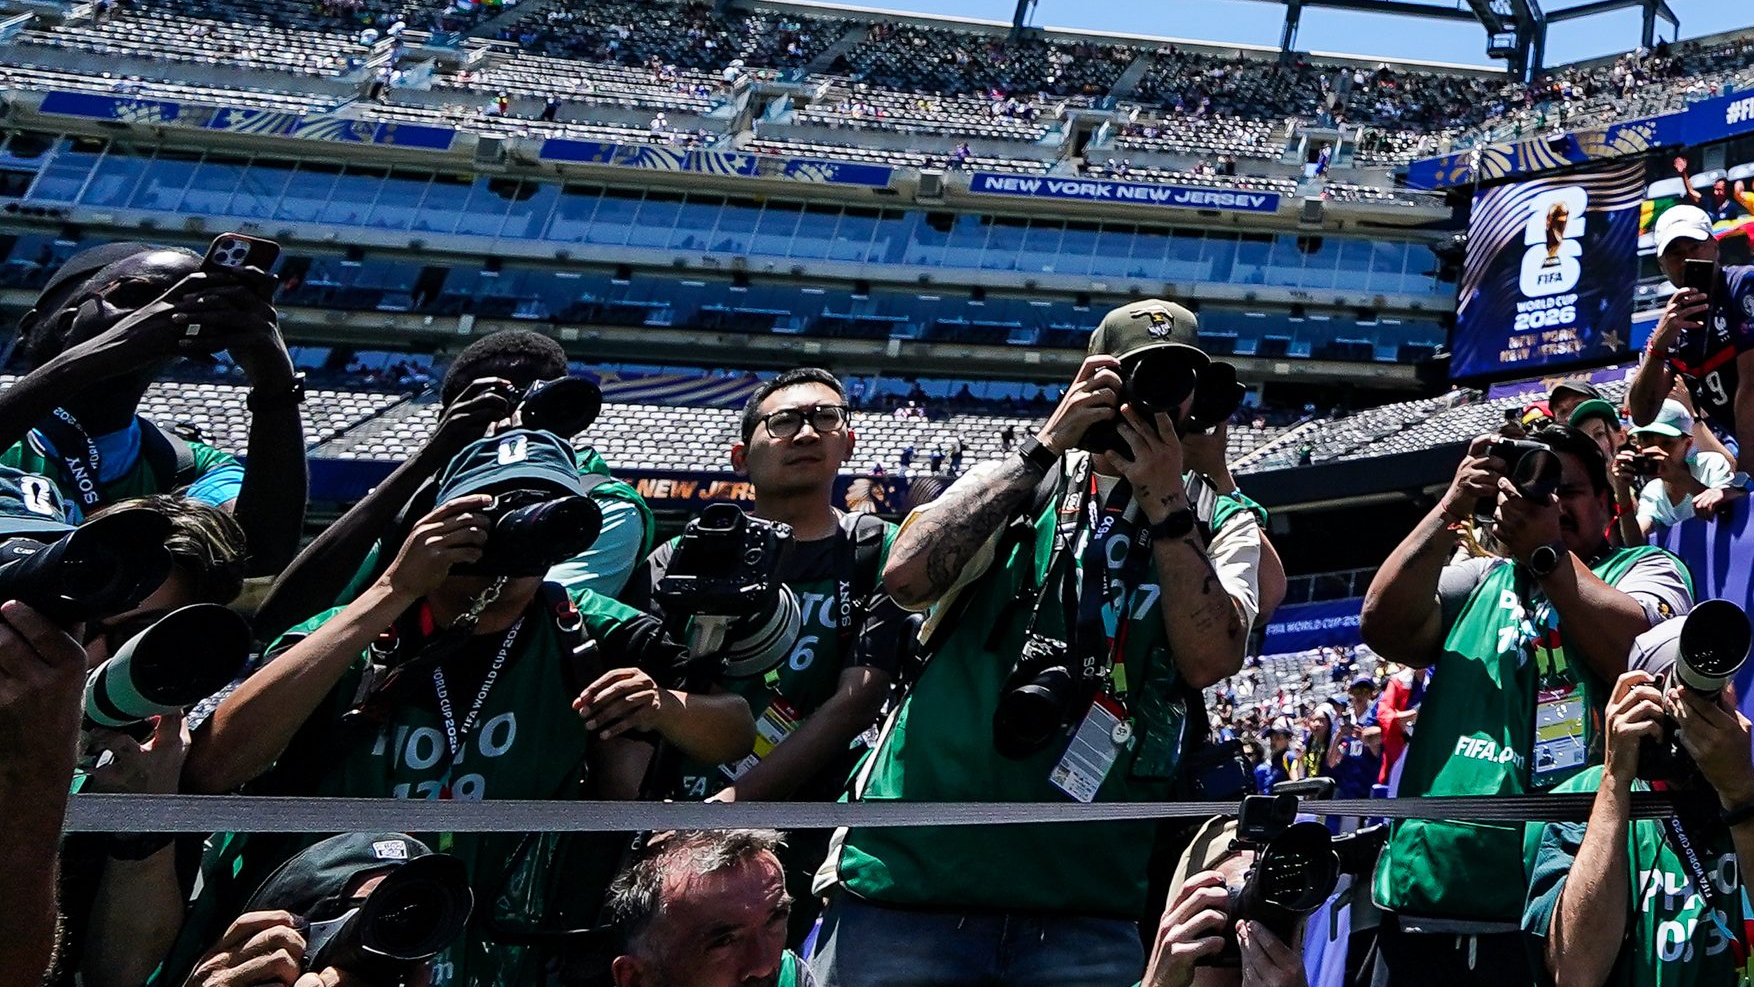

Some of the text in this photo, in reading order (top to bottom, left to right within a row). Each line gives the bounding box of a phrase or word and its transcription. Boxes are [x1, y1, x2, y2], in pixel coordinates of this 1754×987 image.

[985, 176, 1266, 207] NEW YORK NEW JERSEY
[1537, 272, 1563, 285] FIFA
[1517, 293, 1578, 313] WORLD CUP
[1514, 305, 1576, 331] 2026
[64, 456, 100, 504] SONY
[635, 478, 698, 500] NEW
[839, 579, 852, 628] SONY
[460, 709, 478, 735] FIFA
[472, 670, 498, 710] WORLD
[492, 649, 508, 670] CUP
[440, 699, 453, 721] CUP
[1678, 832, 1690, 849] CUP
[1686, 848, 1705, 881] WORLD
[1699, 878, 1713, 900] FIFA
